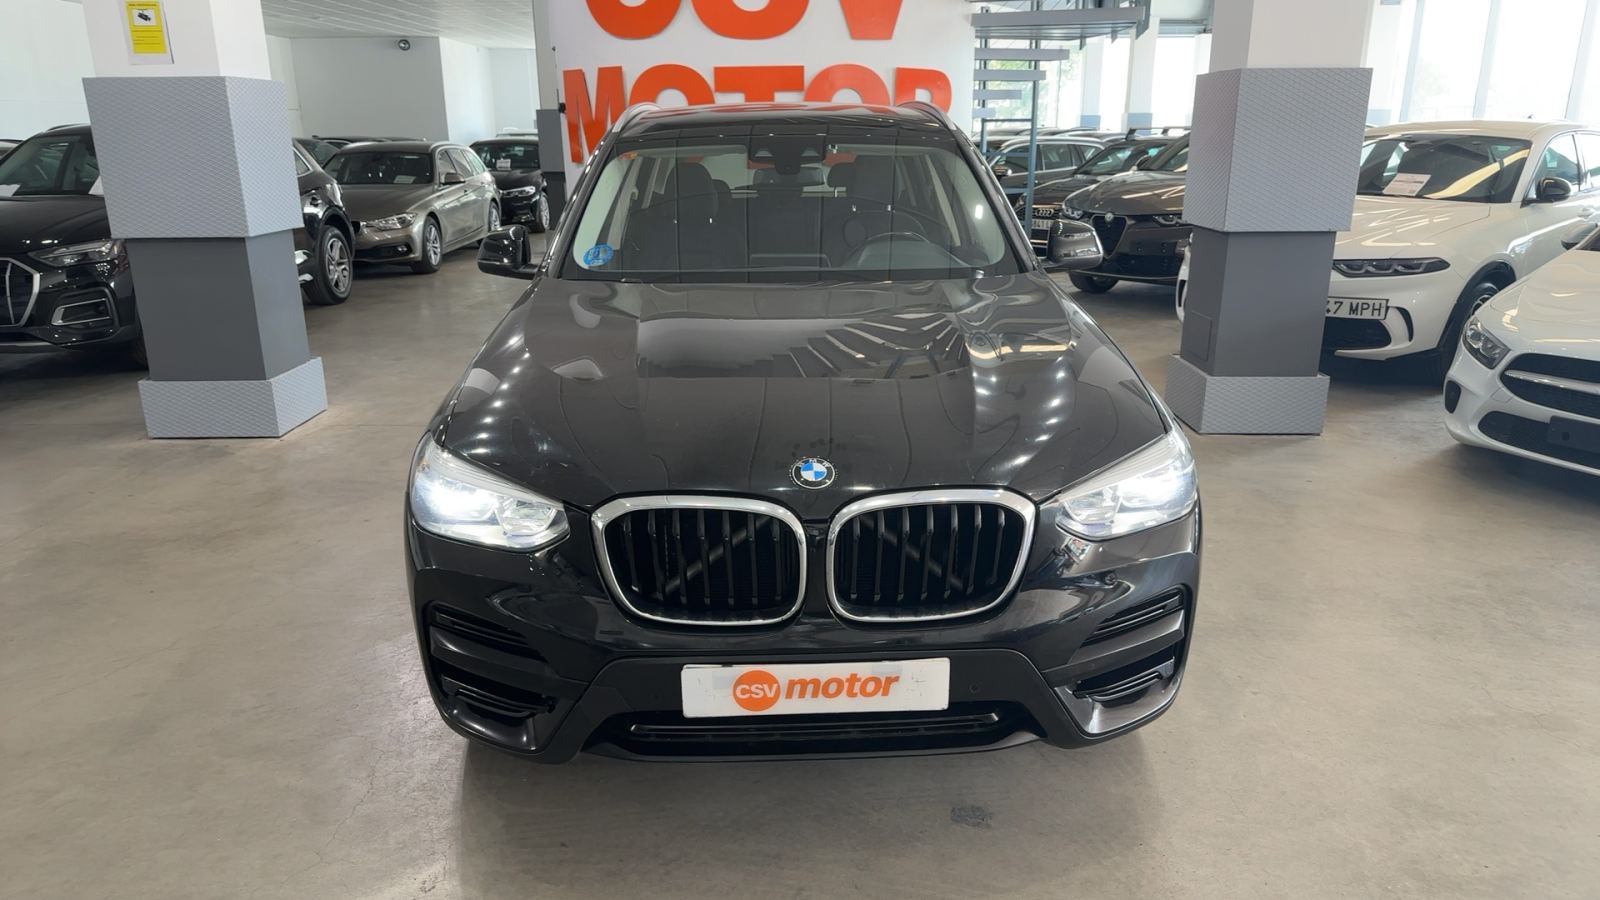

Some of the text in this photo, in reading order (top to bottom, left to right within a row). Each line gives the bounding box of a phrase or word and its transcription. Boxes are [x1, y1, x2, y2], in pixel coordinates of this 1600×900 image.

[1348, 302, 1383, 316] MPH
[735, 673, 900, 700] CSV motor
